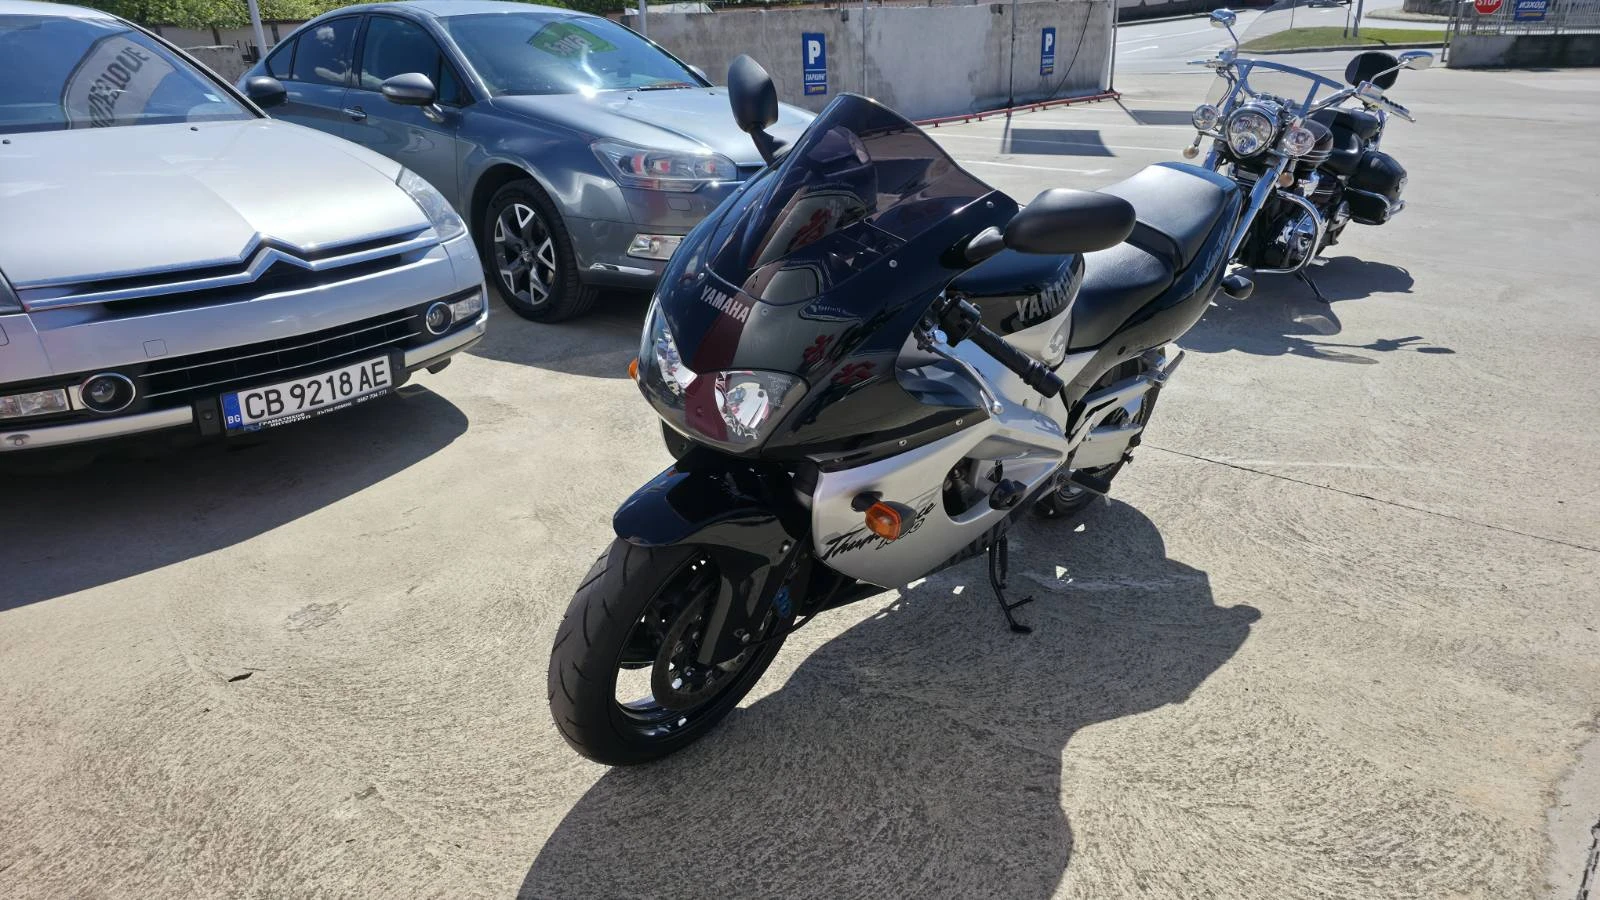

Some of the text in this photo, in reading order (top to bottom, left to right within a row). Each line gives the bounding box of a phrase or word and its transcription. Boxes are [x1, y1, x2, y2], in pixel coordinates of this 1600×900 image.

[1518, 1, 1546, 9] ИЗХОД
[808, 40, 821, 64] P
[1045, 33, 1053, 52] P
[805, 73, 826, 81] ПАРКИНГ
[700, 285, 750, 323] YAMAHA
[245, 360, 388, 420] CB 9218 AE
[227, 415, 241, 424] BG
